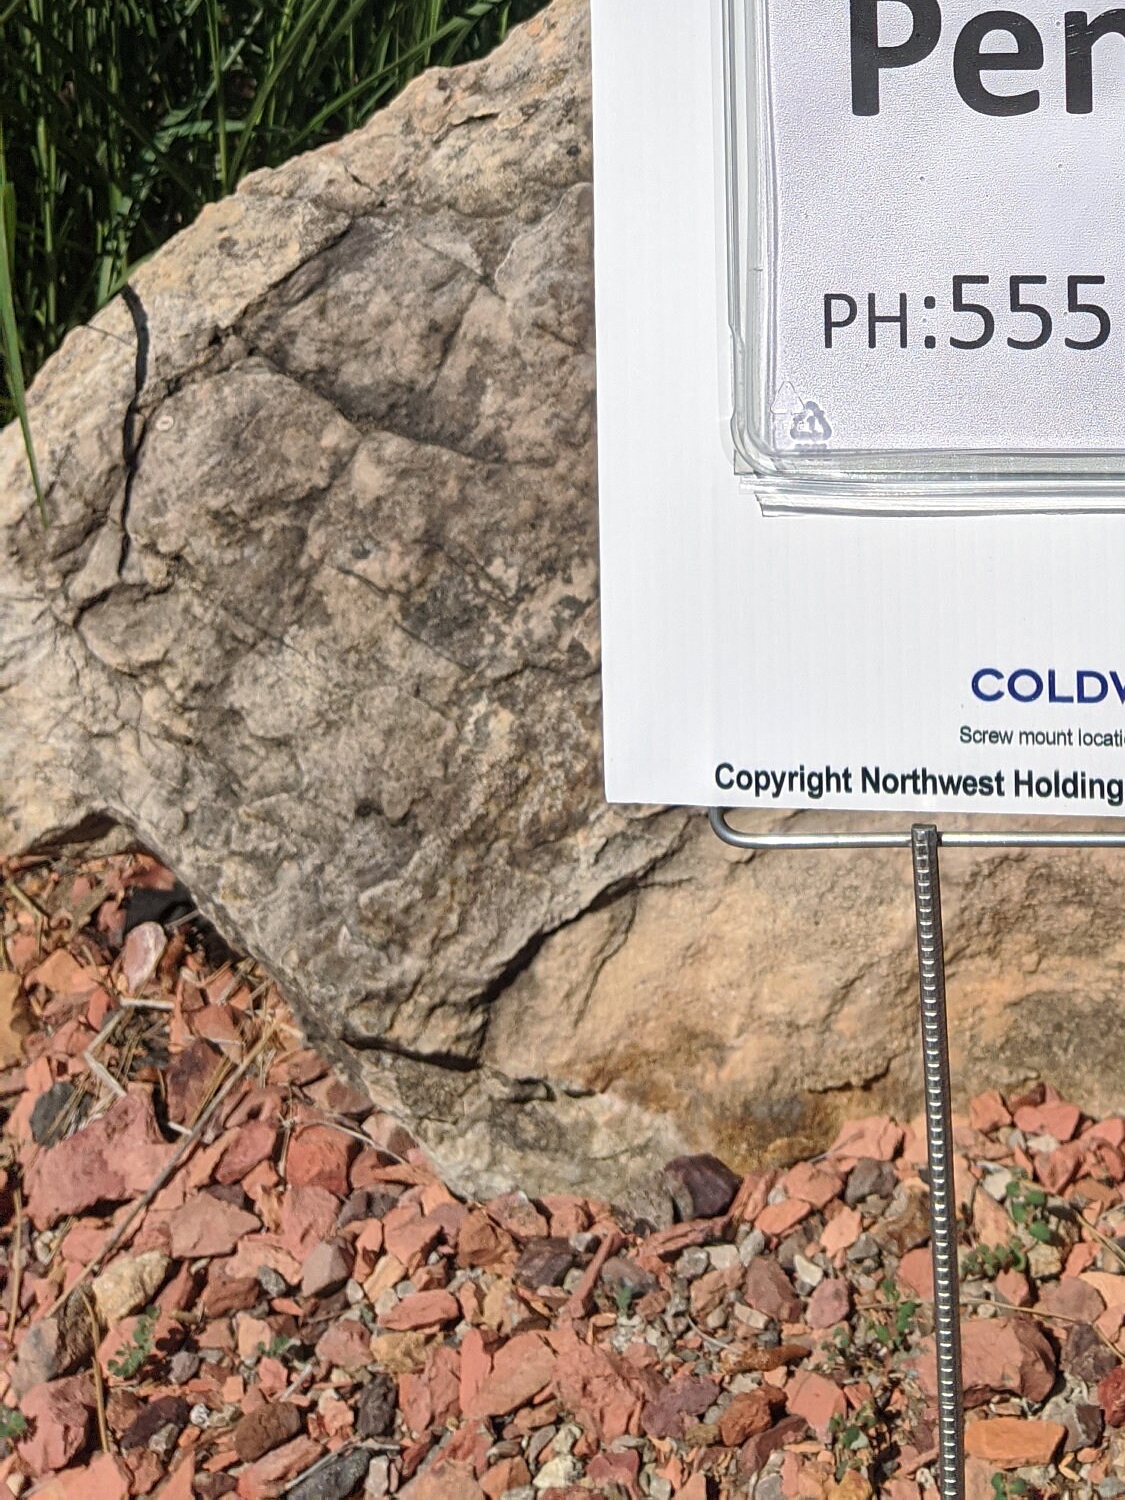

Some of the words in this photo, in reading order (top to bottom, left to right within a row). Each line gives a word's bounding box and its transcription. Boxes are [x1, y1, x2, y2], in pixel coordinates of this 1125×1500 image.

[959, 725, 1014, 746] Screw
[1019, 728, 1074, 747] mount
[715, 762, 853, 800] Copyright
[861, 766, 1005, 798] Northwest
